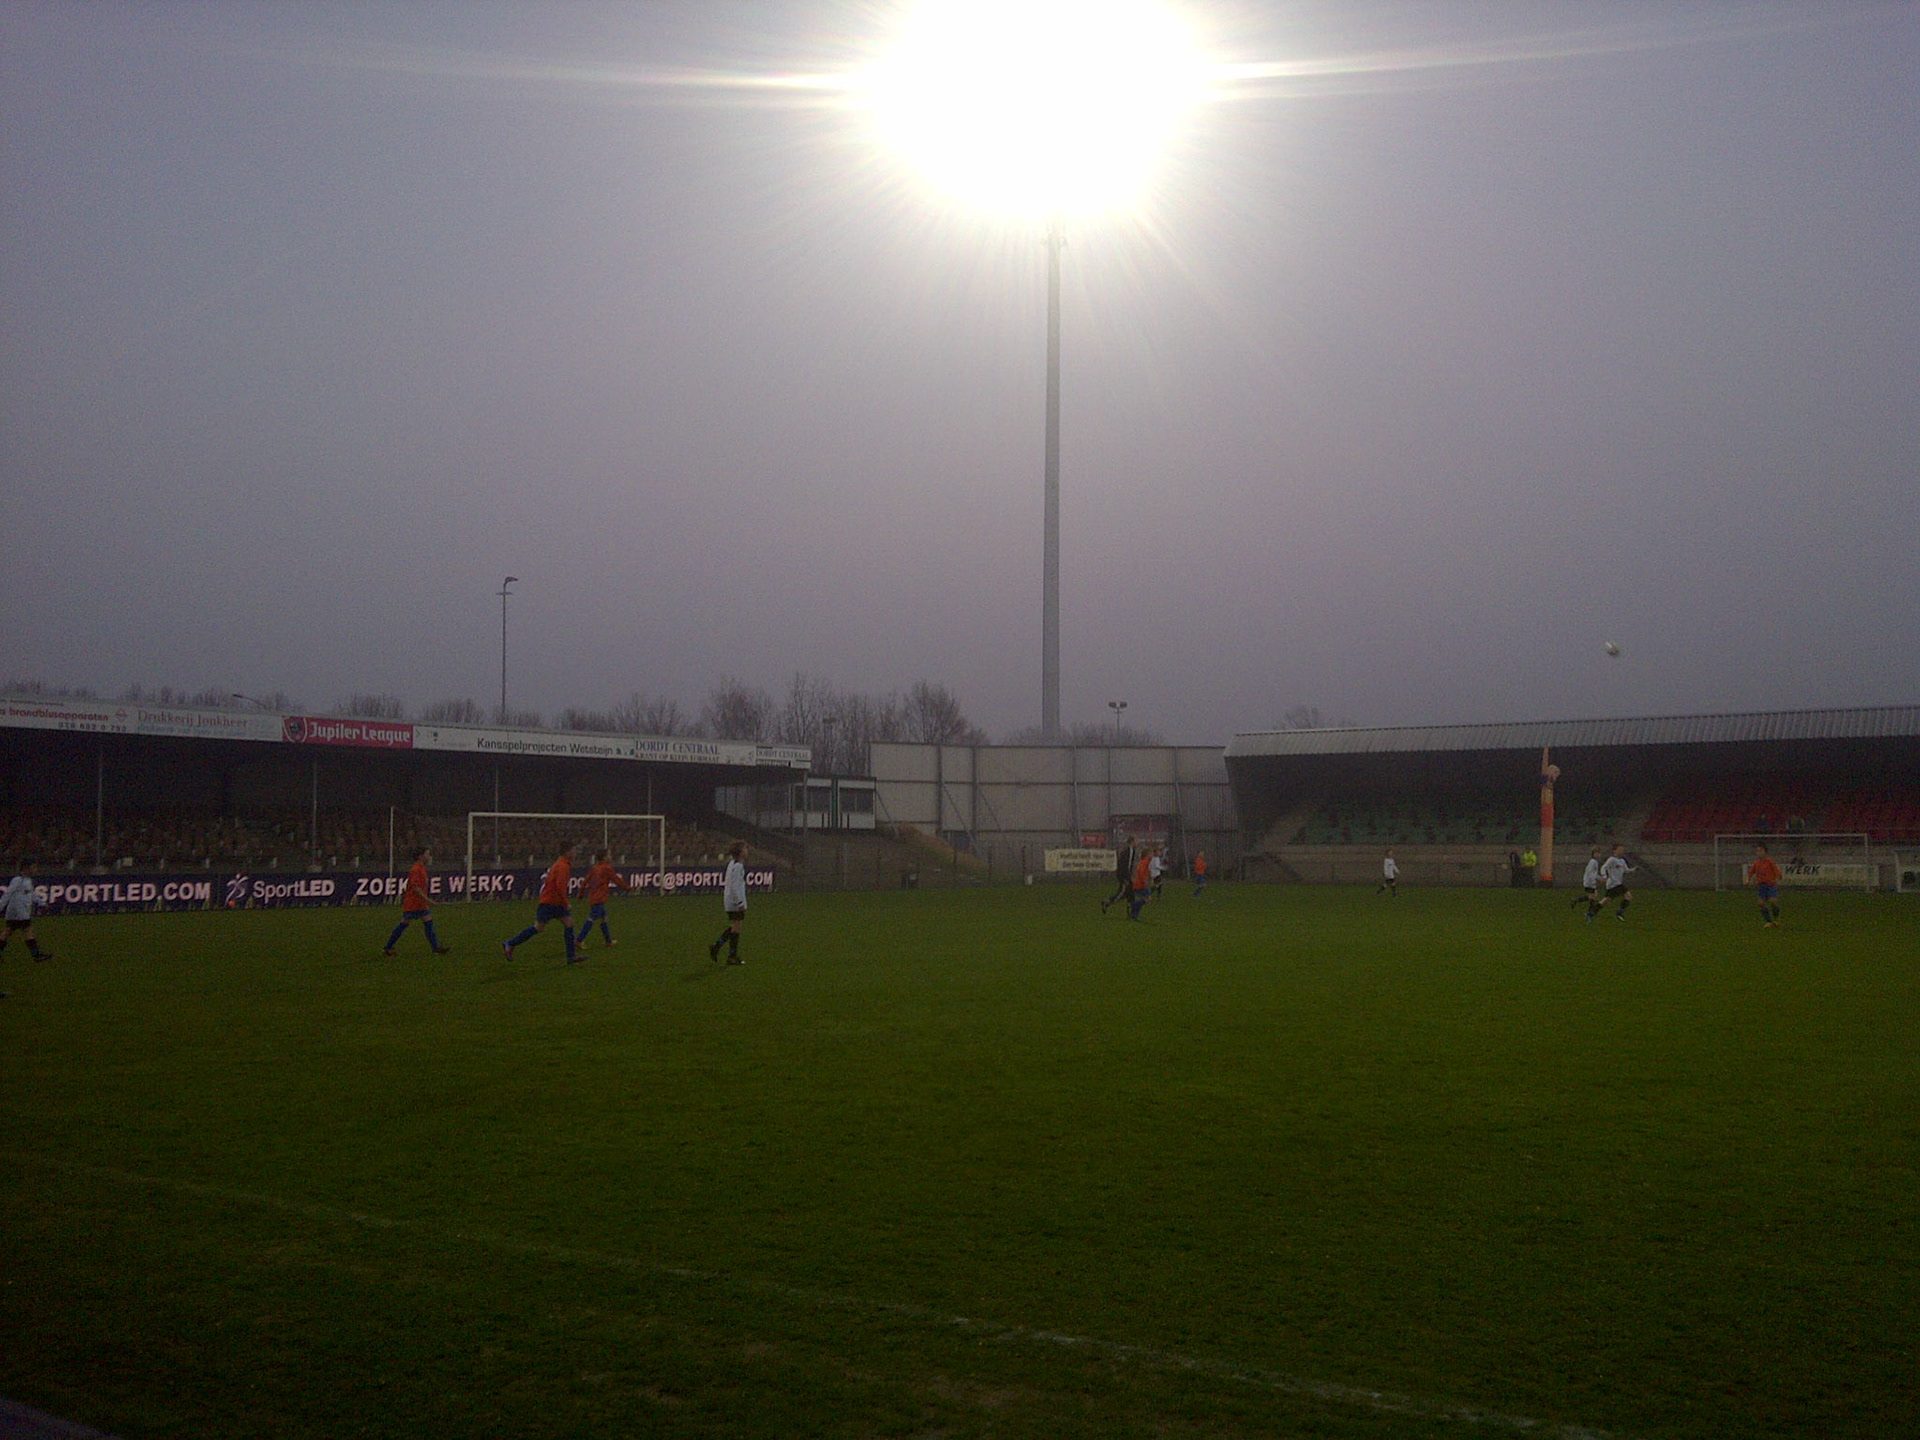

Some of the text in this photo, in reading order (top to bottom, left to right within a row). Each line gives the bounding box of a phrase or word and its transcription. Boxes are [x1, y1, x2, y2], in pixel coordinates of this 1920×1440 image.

[137, 710, 193, 727] Drukkerij
[308, 722, 411, 746] Jupiler League
[476, 737, 567, 754] Kansspelprojecten
[635, 740, 720, 756] DORDT CENTRAAL
[252, 880, 335, 904] SportLED
[449, 875, 515, 894] WERK?
